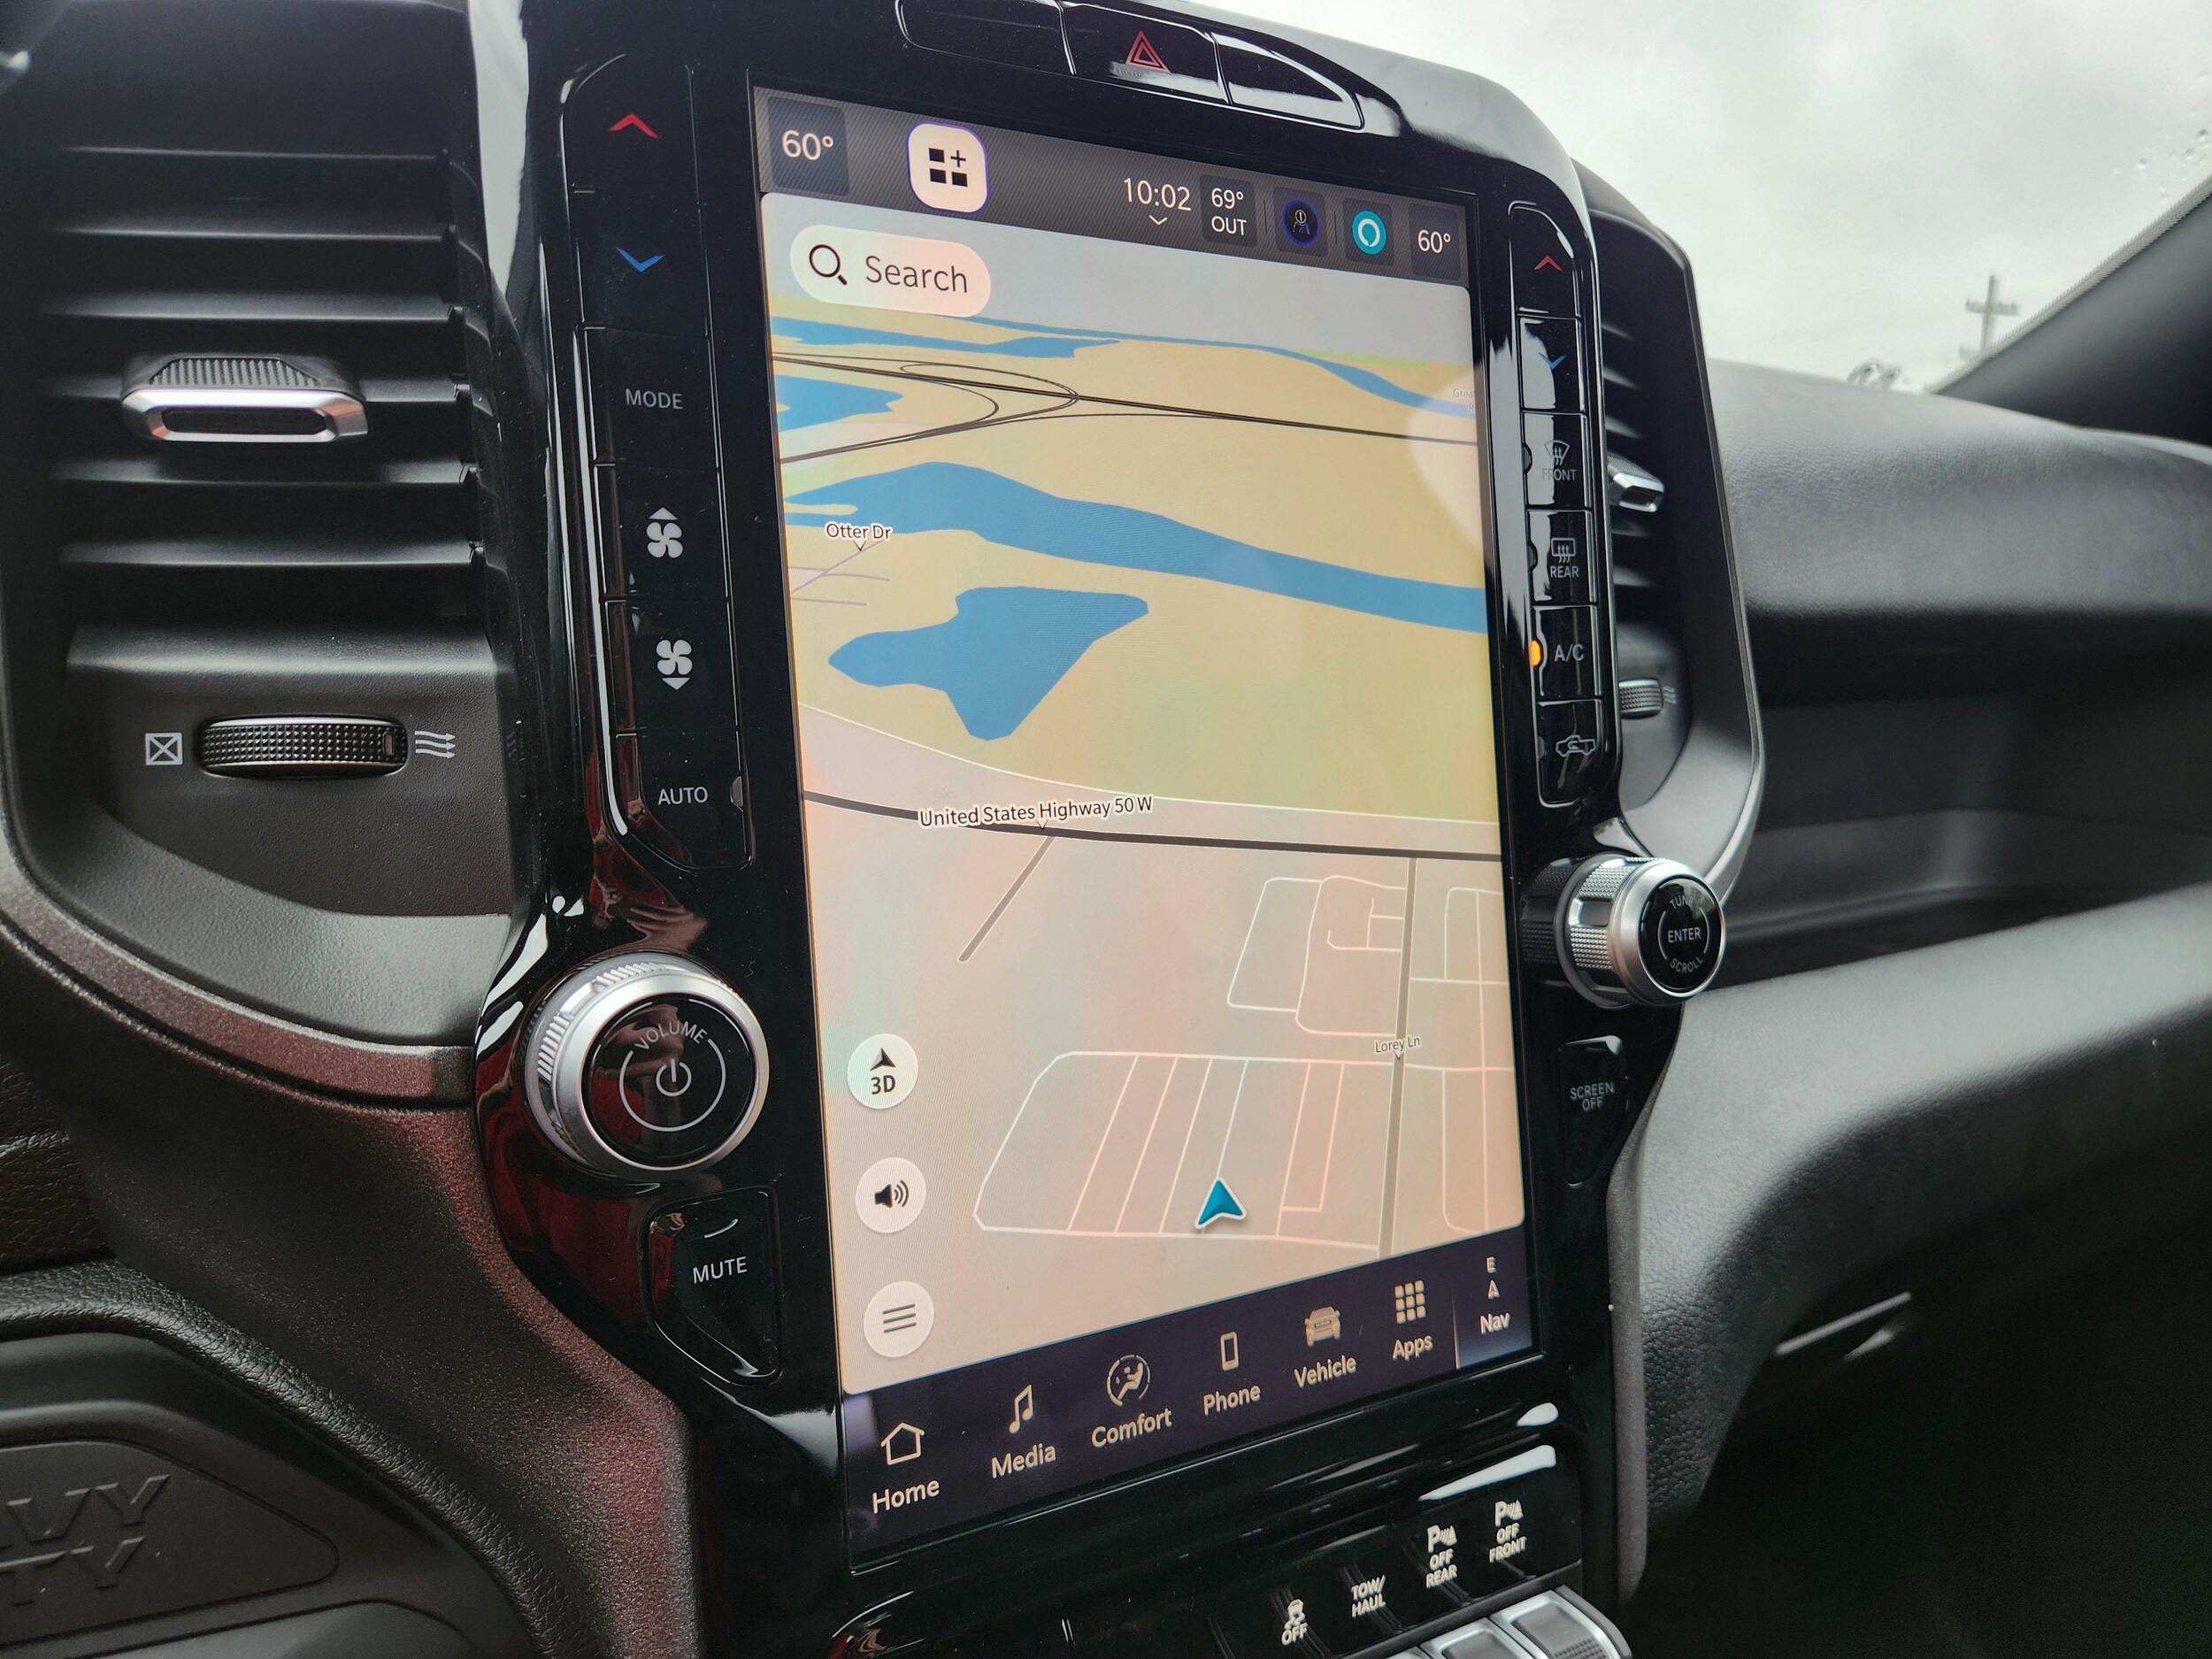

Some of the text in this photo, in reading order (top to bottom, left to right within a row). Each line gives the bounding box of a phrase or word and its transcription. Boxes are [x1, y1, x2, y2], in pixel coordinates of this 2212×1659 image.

[781, 130, 833, 160] 60°
[1124, 178, 1192, 211] 10:02
[1211, 187, 1244, 210] 69°
[1211, 215, 1247, 236] OUT
[1417, 229, 1451, 254] 60°
[865, 255, 967, 293] Search
[626, 389, 683, 410] MODE
[1541, 468, 1577, 482] FRONT
[826, 523, 892, 540] Otter Dr
[1550, 565, 1579, 579] REAR
[1555, 644, 1585, 662] A/C
[657, 787, 708, 805] AUTO
[920, 796, 1153, 826] United States Highway 50 W
[1669, 895, 1694, 909] TUNE
[1668, 928, 1701, 943] ENTER
[1671, 956, 1703, 973] SCROLL
[635, 1020, 707, 1052] VOLUME
[1375, 1035, 1421, 1053] Lorey Ln
[871, 1074, 896, 1095] 3D
[1570, 1081, 1615, 1099] SCREEN
[1582, 1096, 1604, 1111] OFF
[693, 1256, 748, 1284] MUTE
[1486, 1256, 1497, 1273] E
[1480, 1313, 1510, 1334] Nav
[1393, 1335, 1433, 1361] Apps
[1294, 1355, 1357, 1388] Vehicle
[1202, 1383, 1262, 1416] Phone
[1091, 1407, 1173, 1449] Comfort
[991, 1441, 1057, 1479] Media
[872, 1476, 941, 1514] Home
[1496, 1522, 1520, 1545] OFF
[1429, 1548, 1454, 1571] OFF
[1488, 1536, 1527, 1563] FRONT
[1351, 1574, 1386, 1601] TOW/
[1426, 1564, 1458, 1589] REAR
[1351, 1593, 1386, 1618] HAUL
[1281, 1622, 1308, 1646] OFF
